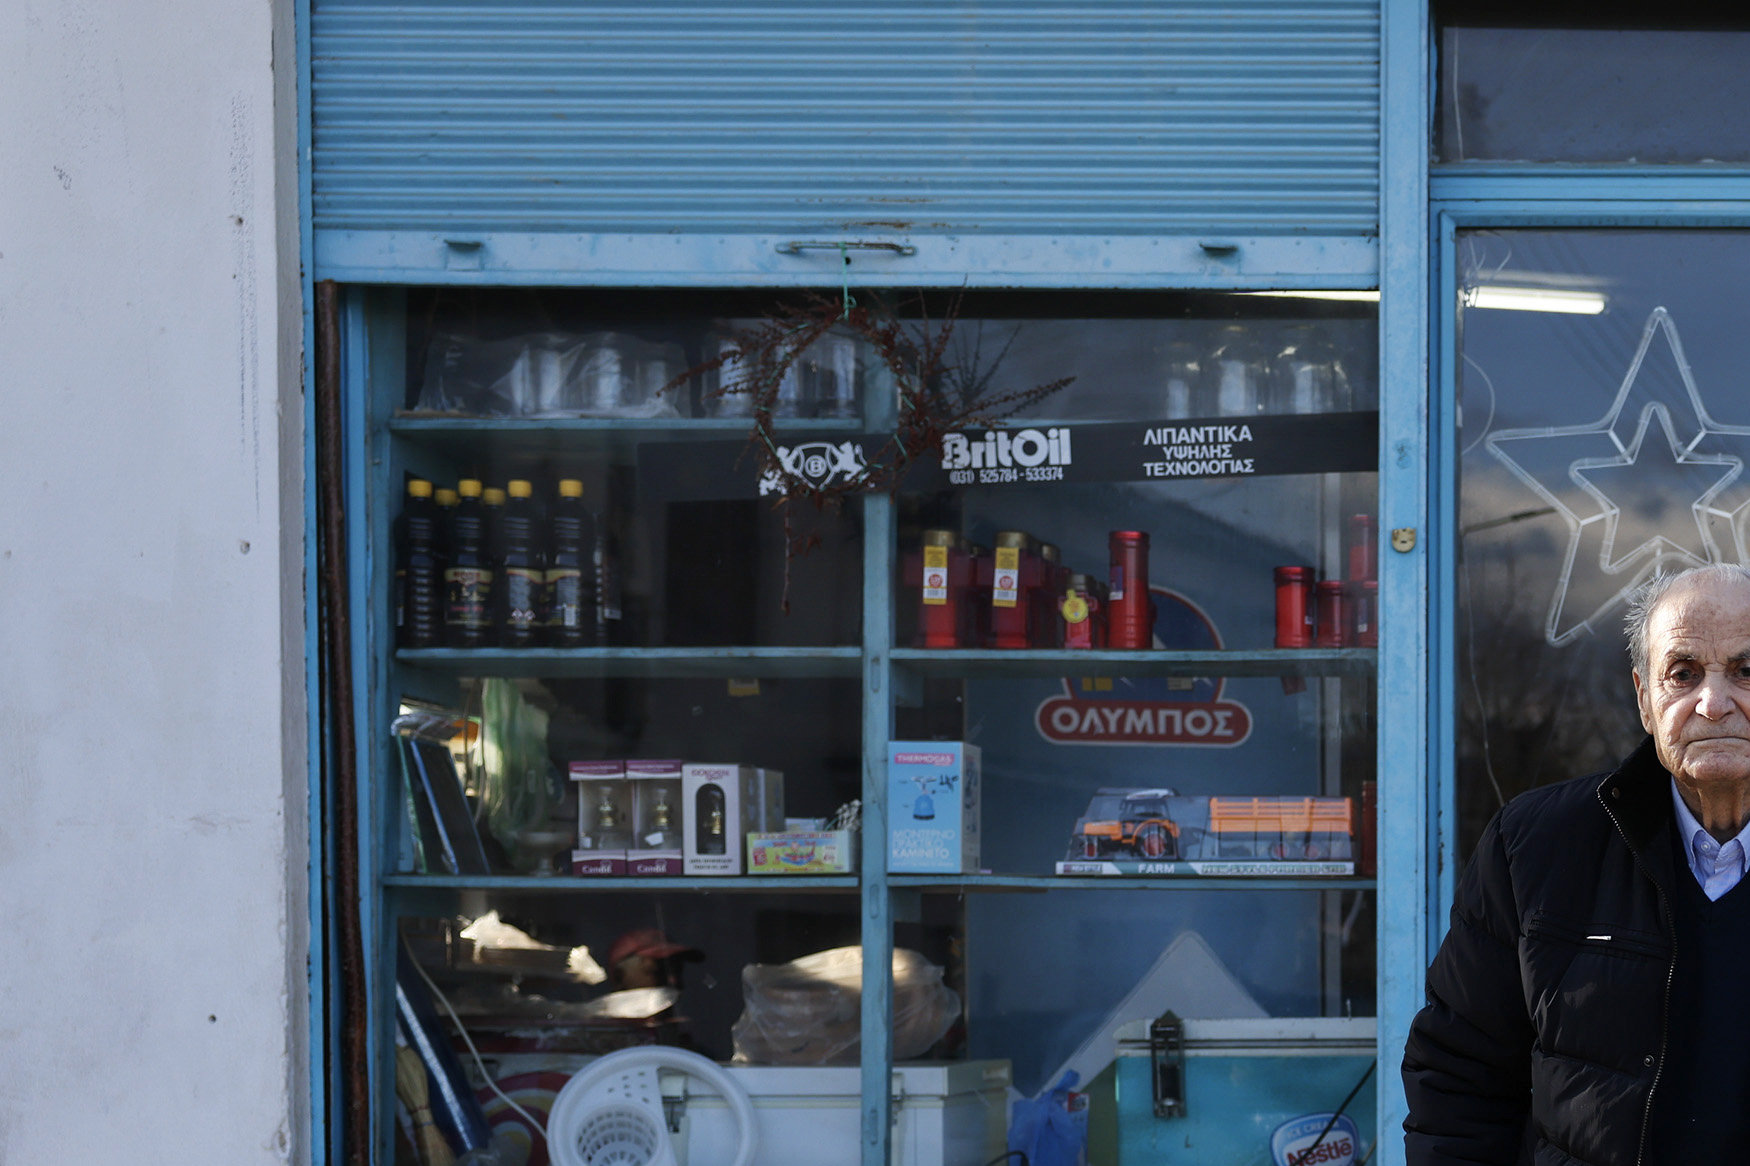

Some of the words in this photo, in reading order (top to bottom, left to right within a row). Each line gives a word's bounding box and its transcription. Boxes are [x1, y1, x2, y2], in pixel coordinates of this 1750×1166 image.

[1143, 424, 1253, 446] ΛΙΠΑΝΤΙΚΑ
[941, 427, 1072, 469] BritOil
[1162, 443, 1233, 461] ΥΨΗΛΗΣ
[949, 469, 975, 485] (031)
[1143, 458, 1255, 477] ΤΕΧΝΟΛΟΓΙΑΣ
[1051, 705, 1235, 737] ΟΛΥΜΠΟΣ
[1138, 864, 1175, 874] FARM
